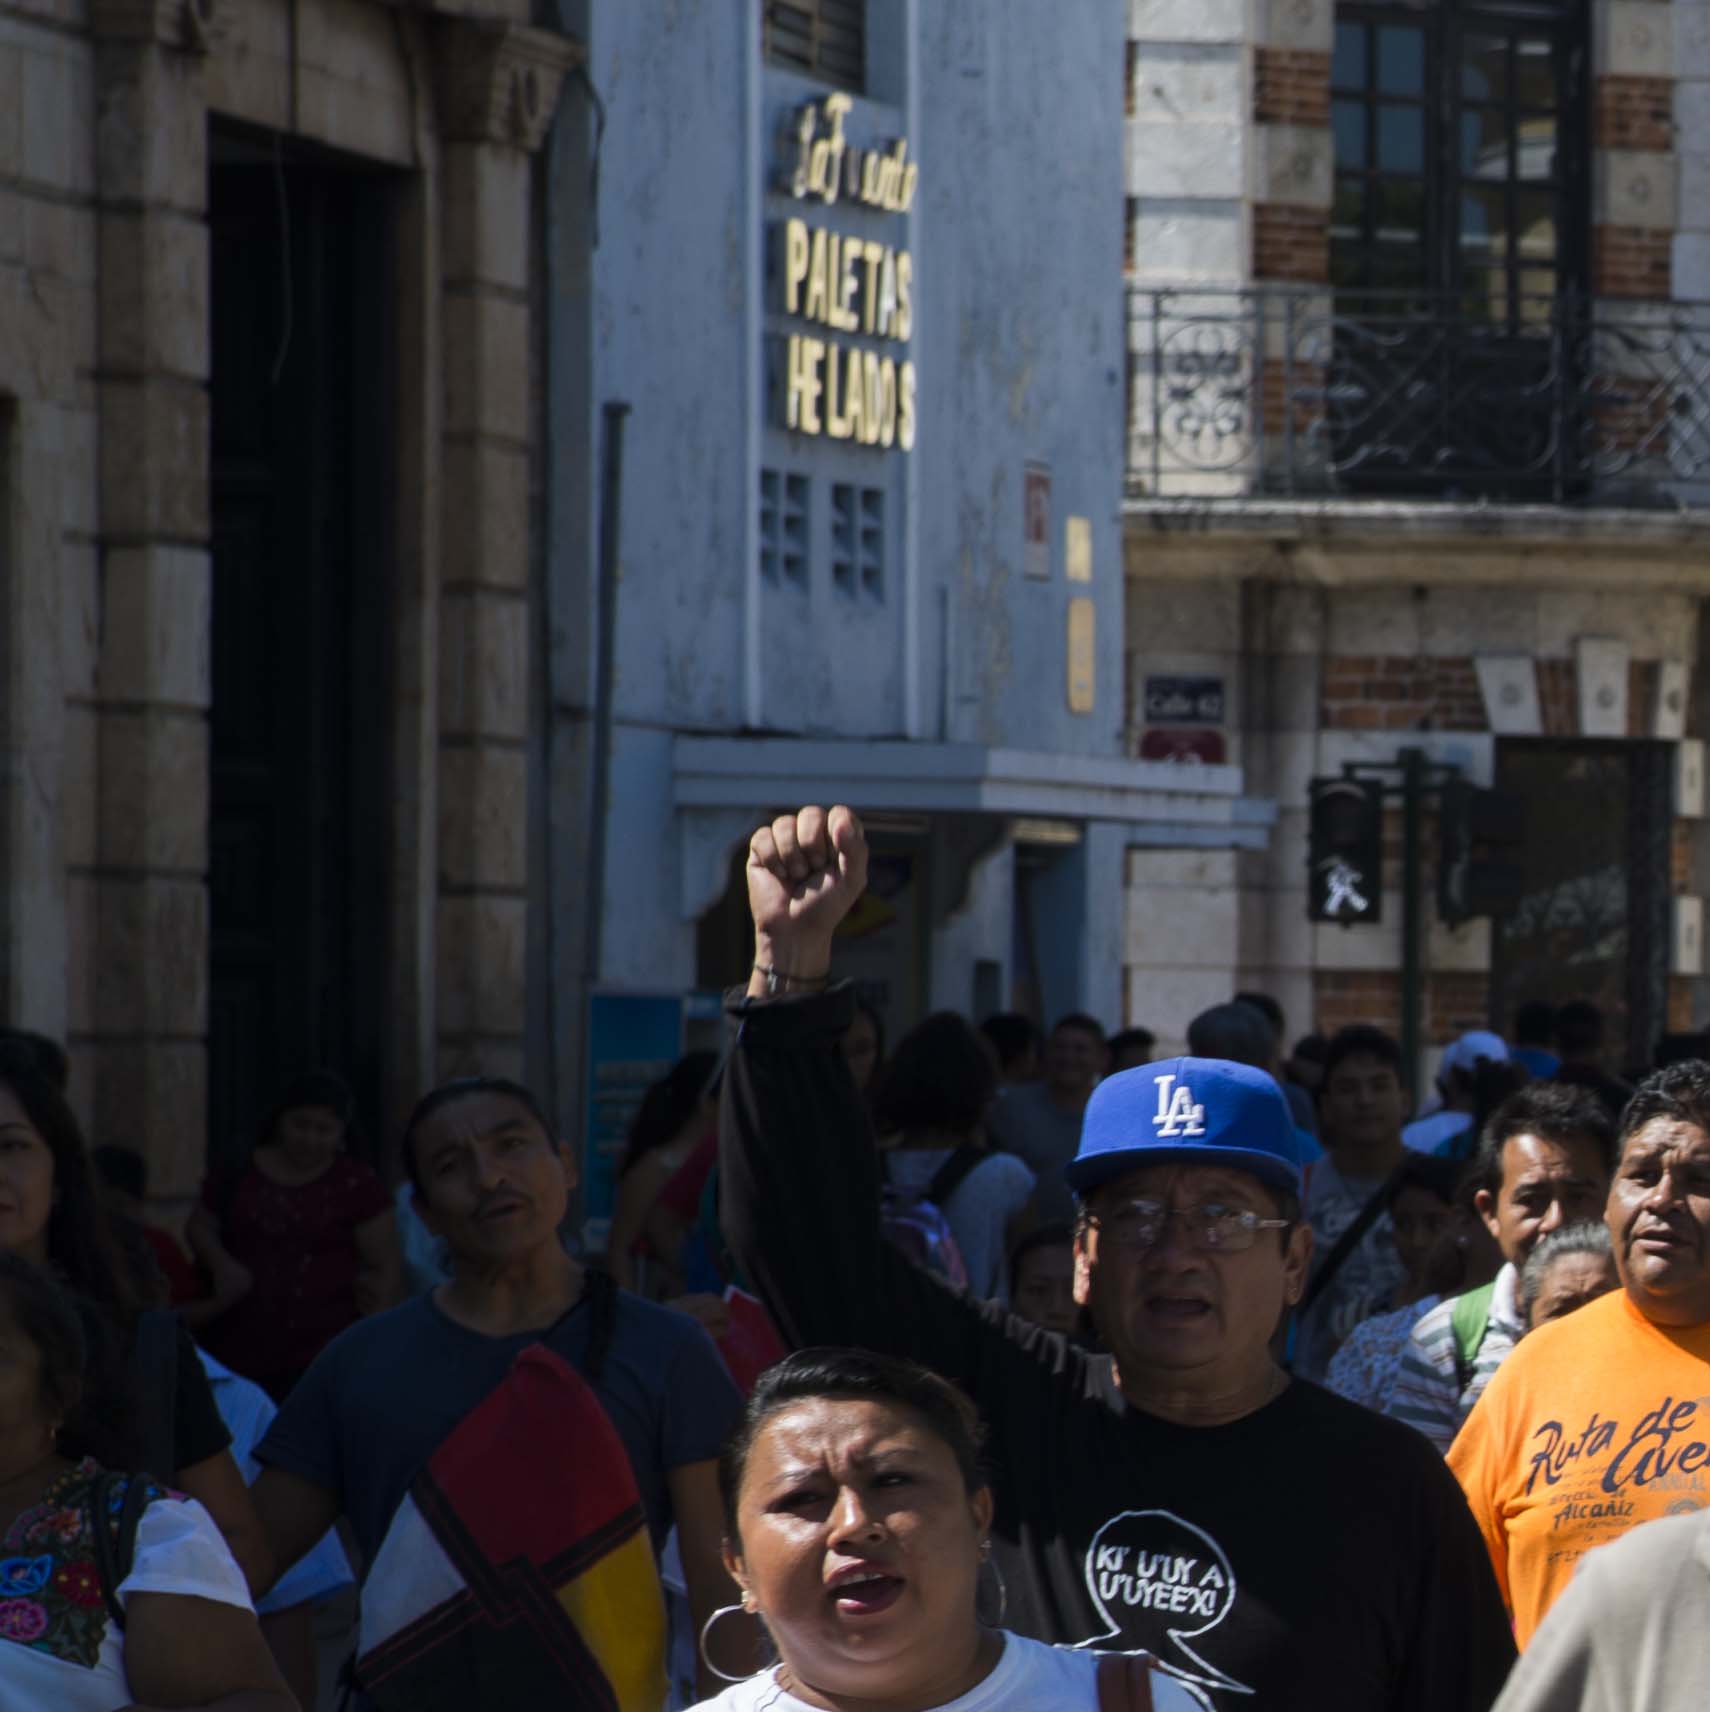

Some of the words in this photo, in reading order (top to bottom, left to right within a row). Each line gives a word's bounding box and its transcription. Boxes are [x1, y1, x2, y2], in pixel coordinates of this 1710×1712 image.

[786, 217, 913, 343] PALETAS
[788, 333, 917, 452] HELADOS
[1152, 1074, 1206, 1137] LA
[1526, 1413, 1619, 1495] Ruta
[1631, 1397, 1698, 1441] de
[1553, 1500, 1635, 1532] Alcañiz
[1096, 1543, 1131, 1571] KI'
[1137, 1549, 1198, 1586] U'UY
[1198, 1563, 1224, 1589] A
